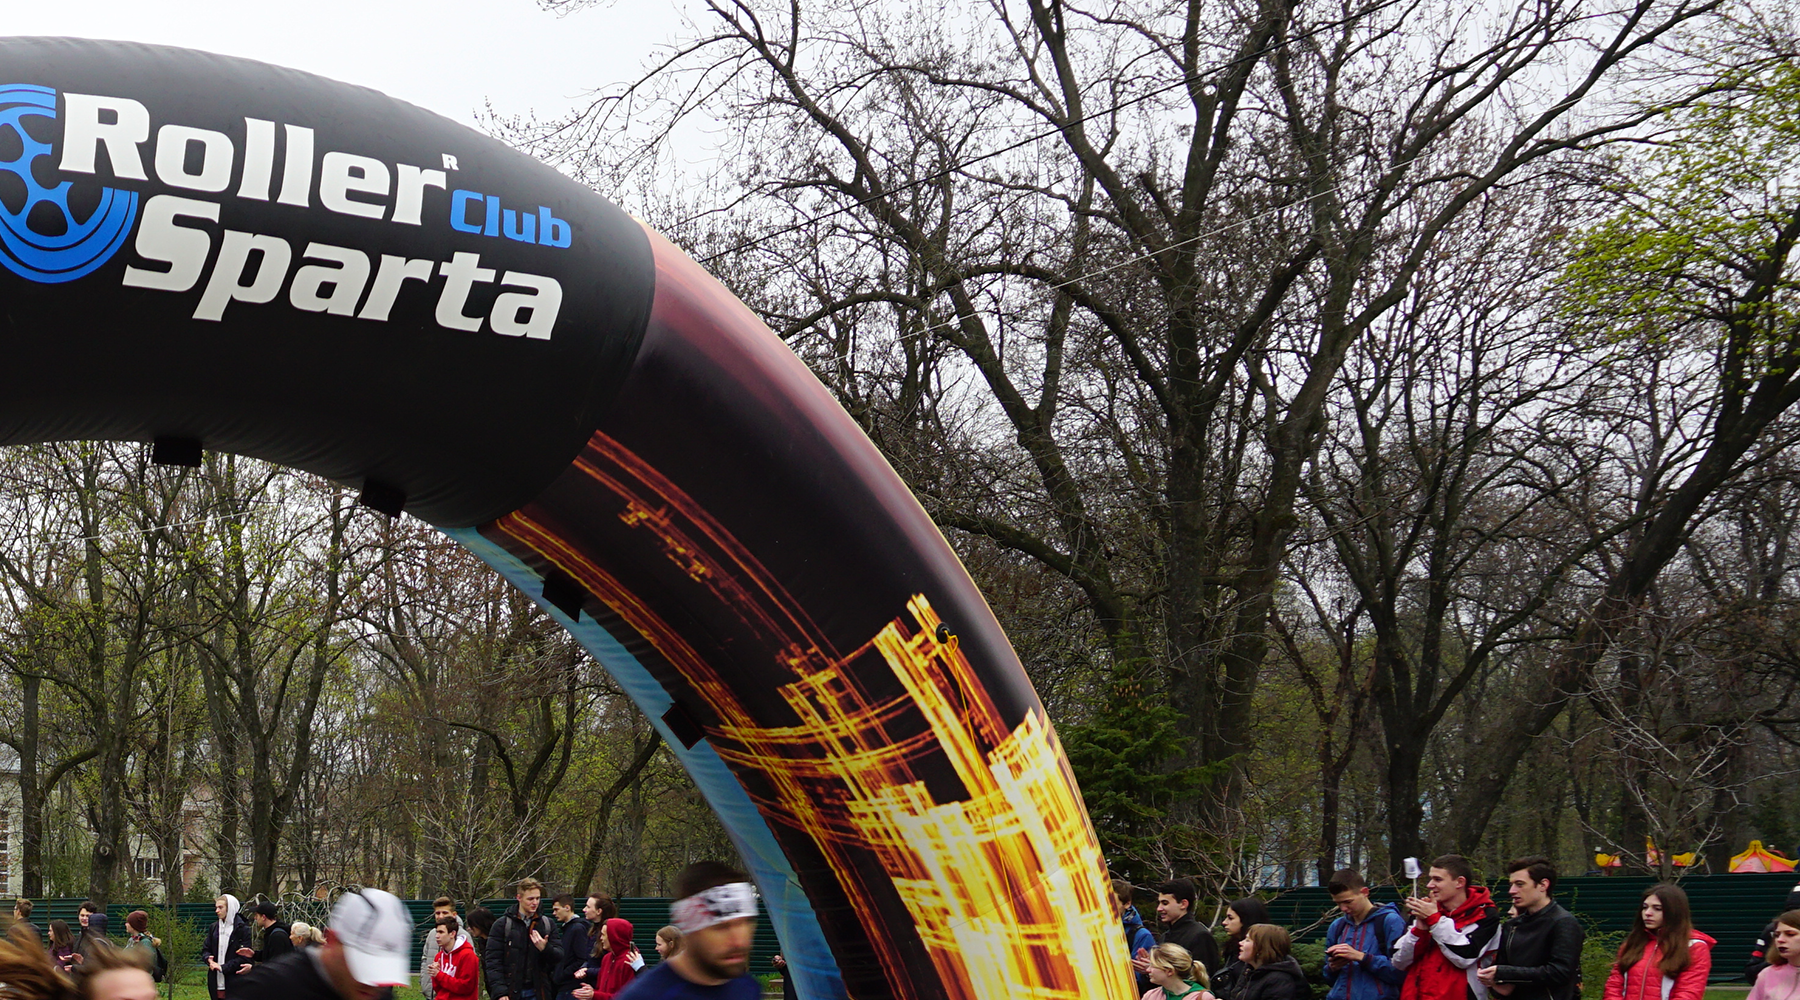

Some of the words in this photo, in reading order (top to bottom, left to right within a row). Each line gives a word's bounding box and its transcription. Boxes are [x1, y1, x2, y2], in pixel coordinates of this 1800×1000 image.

[58, 92, 447, 226] Roller
[449, 188, 573, 249] Club
[121, 194, 564, 341] Sparta
